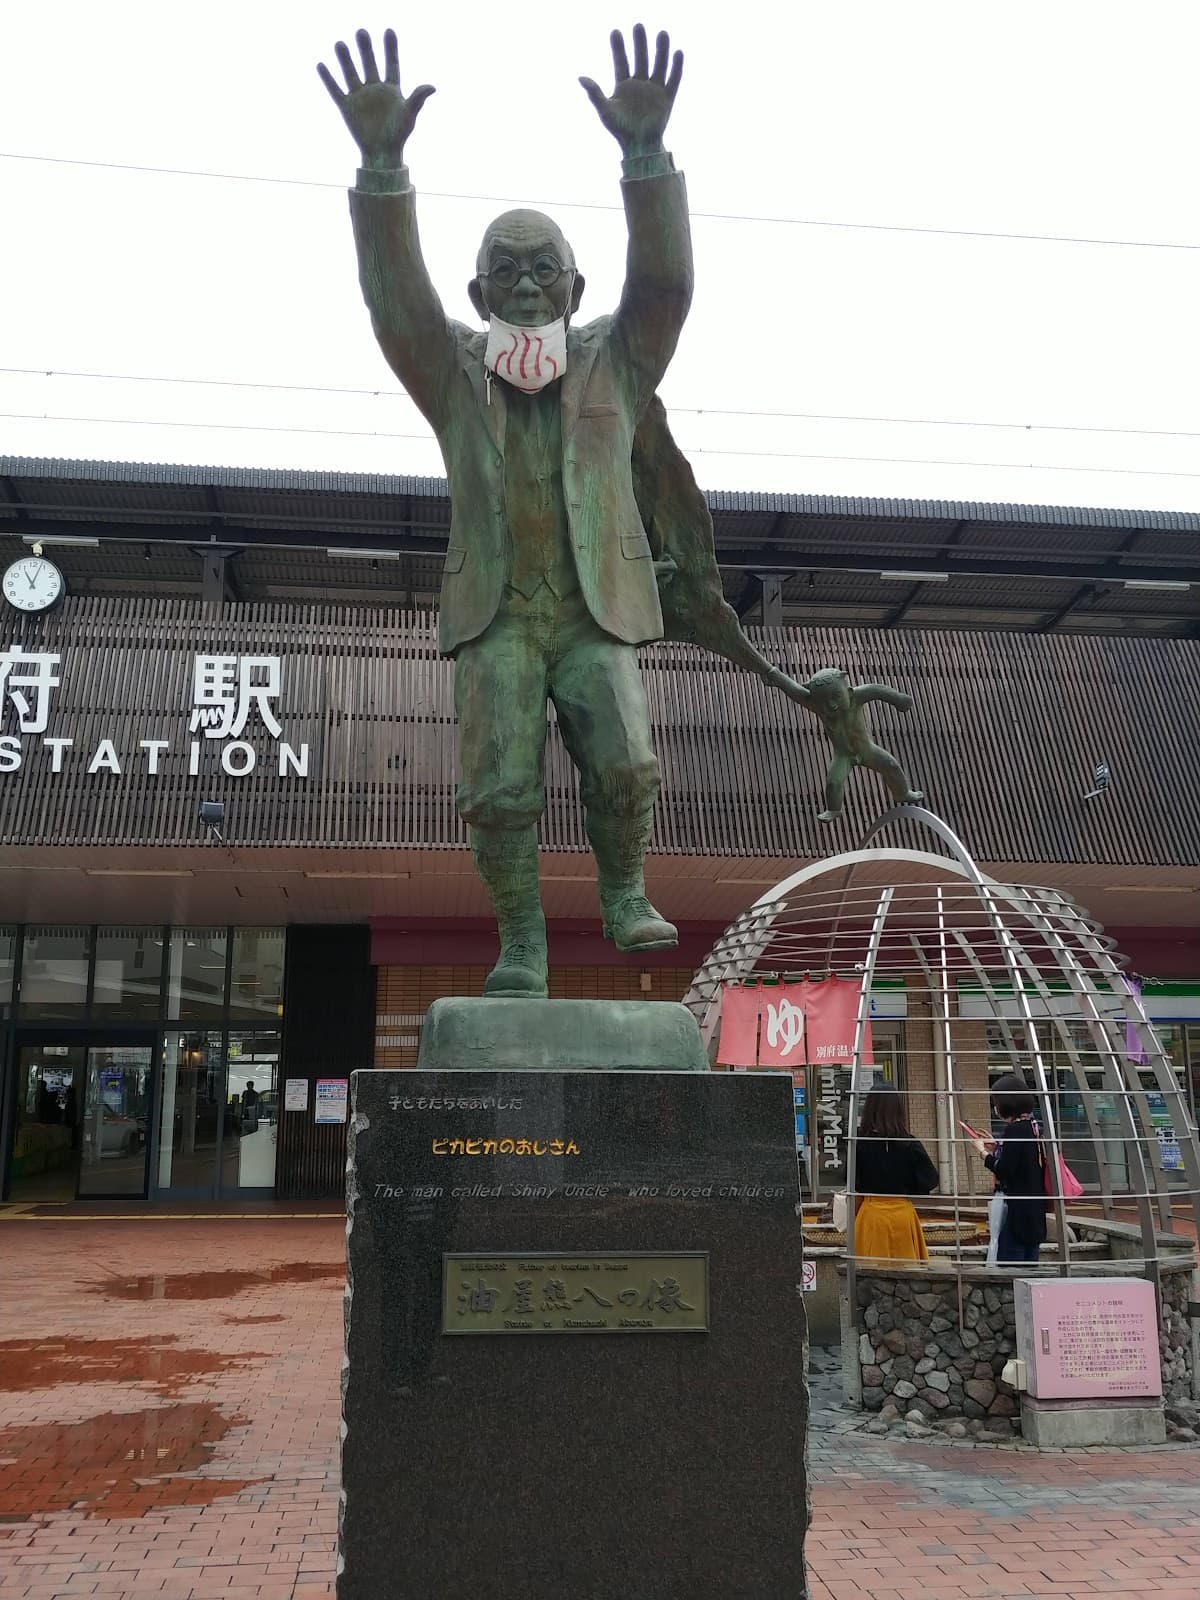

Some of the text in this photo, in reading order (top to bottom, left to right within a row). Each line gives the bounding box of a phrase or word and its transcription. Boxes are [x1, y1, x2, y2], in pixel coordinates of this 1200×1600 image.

[0, 736, 309, 777] STATION
[766, 998, 803, 1057] ゆ
[815, 1064, 843, 1168] milyMart
[432, 1137, 581, 1156] ピカピカのおじさん
[374, 1183, 404, 1198] The
[411, 1186, 444, 1198] man
[450, 1183, 502, 1198] called
[627, 1184, 660, 1198] who
[665, 1183, 714, 1198] loved
[718, 1184, 785, 1198] children
[456, 1275, 695, 1316] 油屋熊八の像
